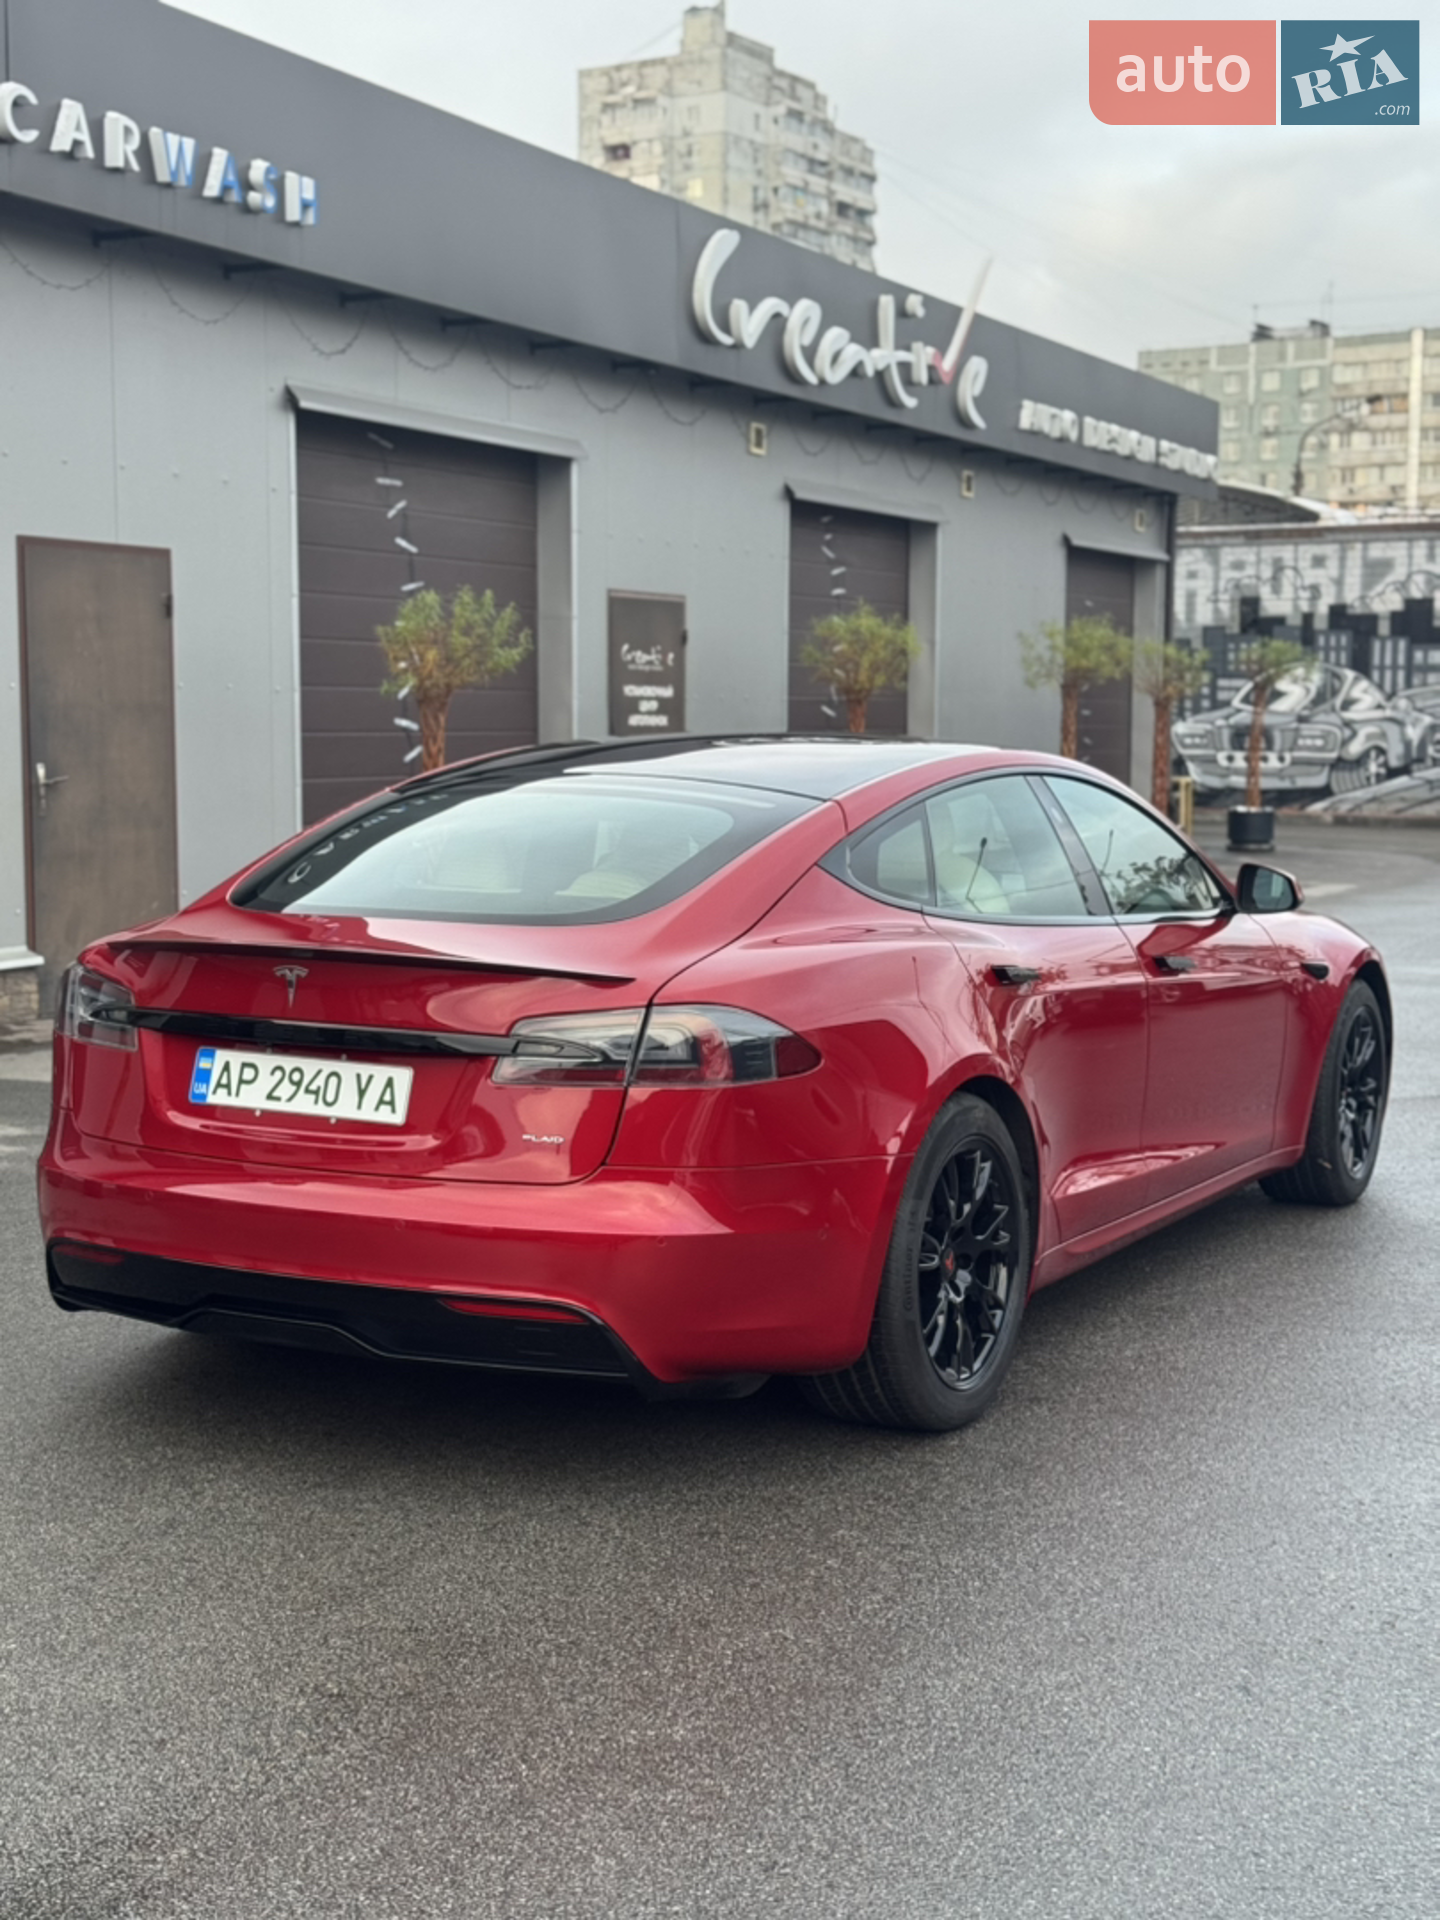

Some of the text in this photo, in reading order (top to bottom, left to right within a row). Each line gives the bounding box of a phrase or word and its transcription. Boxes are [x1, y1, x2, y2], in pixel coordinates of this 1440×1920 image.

[0, 81, 317, 226] CARWASH
[693, 228, 994, 430] Creative
[621, 643, 675, 667] Creatie
[212, 1060, 396, 1114] AP 2940 YA
[522, 1134, 565, 1145] PLAID
